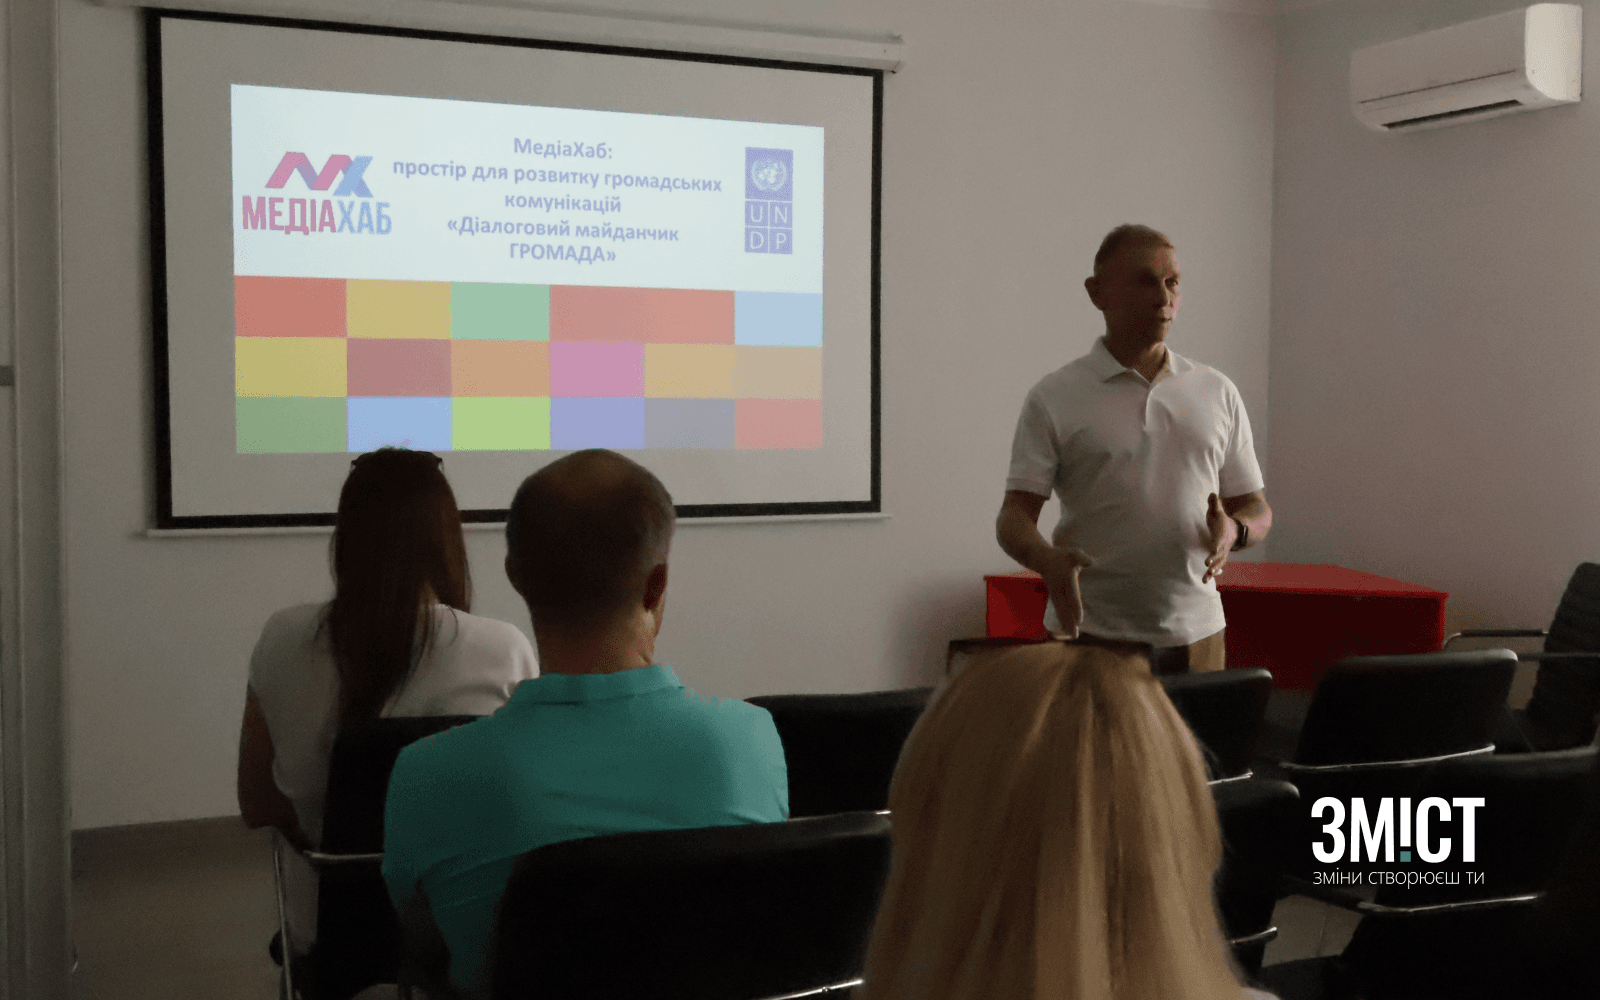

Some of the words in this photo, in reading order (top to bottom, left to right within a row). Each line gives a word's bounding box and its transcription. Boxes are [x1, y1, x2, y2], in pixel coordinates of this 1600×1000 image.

[513, 137, 612, 159] МедіаХаб:
[393, 160, 467, 182] простір
[471, 165, 508, 182] для
[514, 168, 600, 189] розвитку
[604, 173, 722, 192] громадських
[242, 195, 392, 235] МЕДІАХАБ
[504, 194, 621, 215] комунікацій
[447, 216, 571, 237] «Діалоговий
[575, 221, 679, 242] майданчик
[509, 243, 616, 265] ГРОМАДА»
